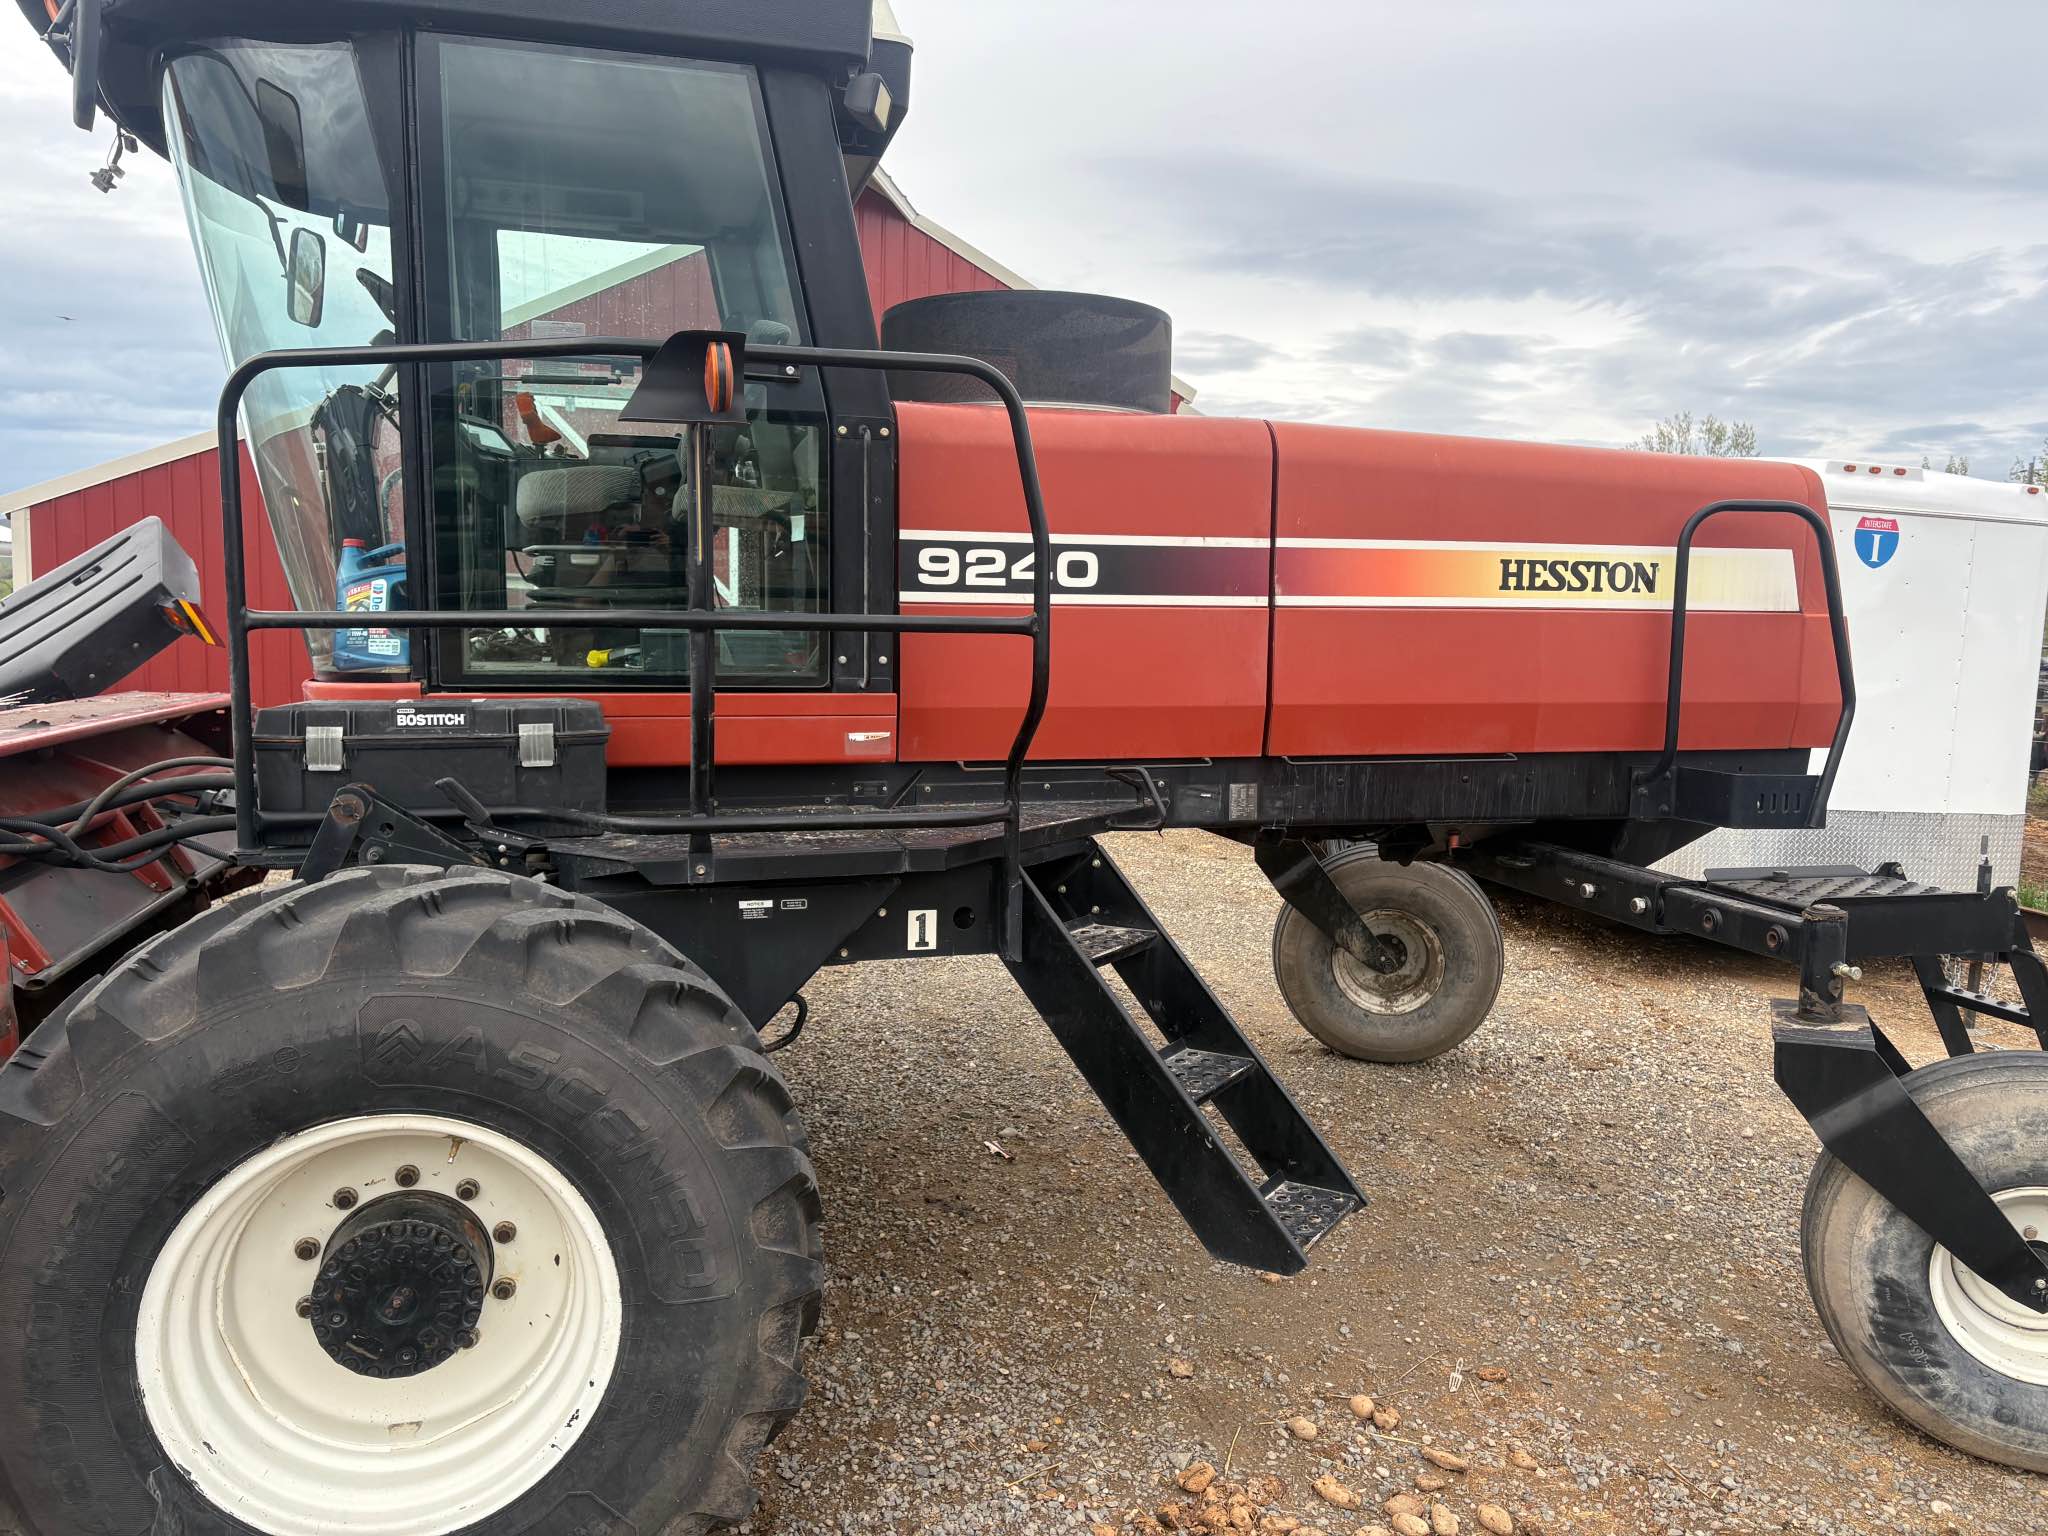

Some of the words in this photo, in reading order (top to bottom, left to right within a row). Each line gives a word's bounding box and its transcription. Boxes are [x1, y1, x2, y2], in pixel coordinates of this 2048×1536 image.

[1864, 520, 1893, 530] INTERSTATE
[1498, 558, 1660, 594] HESSTON
[396, 713, 465, 726] BOSTITCH
[915, 912, 930, 948] 1
